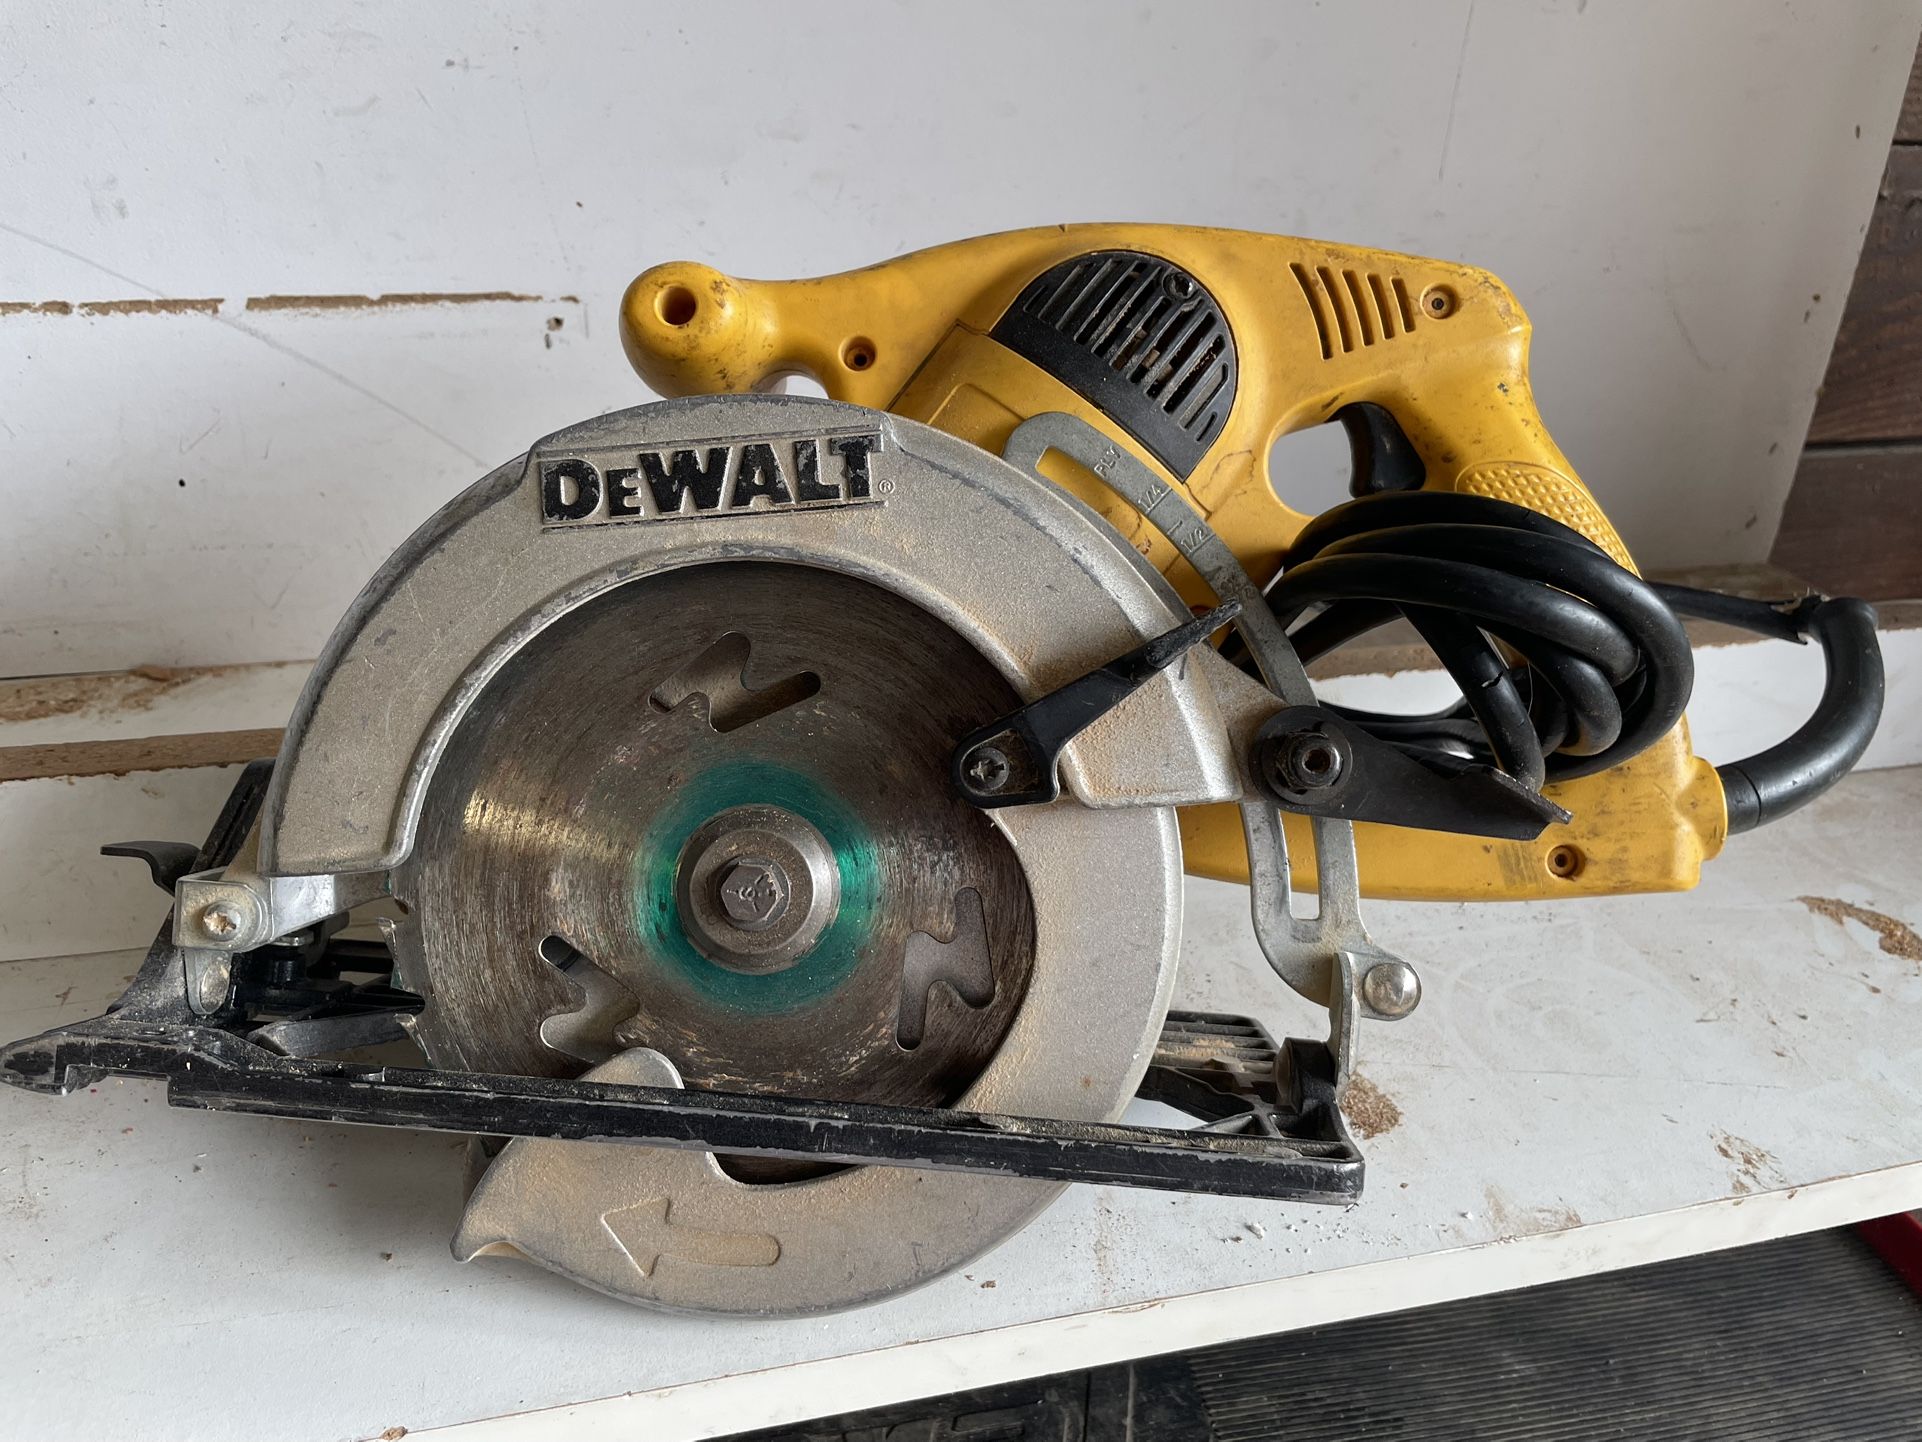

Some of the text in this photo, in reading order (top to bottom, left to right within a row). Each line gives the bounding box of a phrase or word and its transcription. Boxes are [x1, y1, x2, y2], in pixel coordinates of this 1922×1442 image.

[1093, 444, 1121, 478] PLY
[542, 433, 884, 522] DEWALT
[1137, 484, 1165, 512] 1/4
[1180, 528, 1206, 554] 1/2
